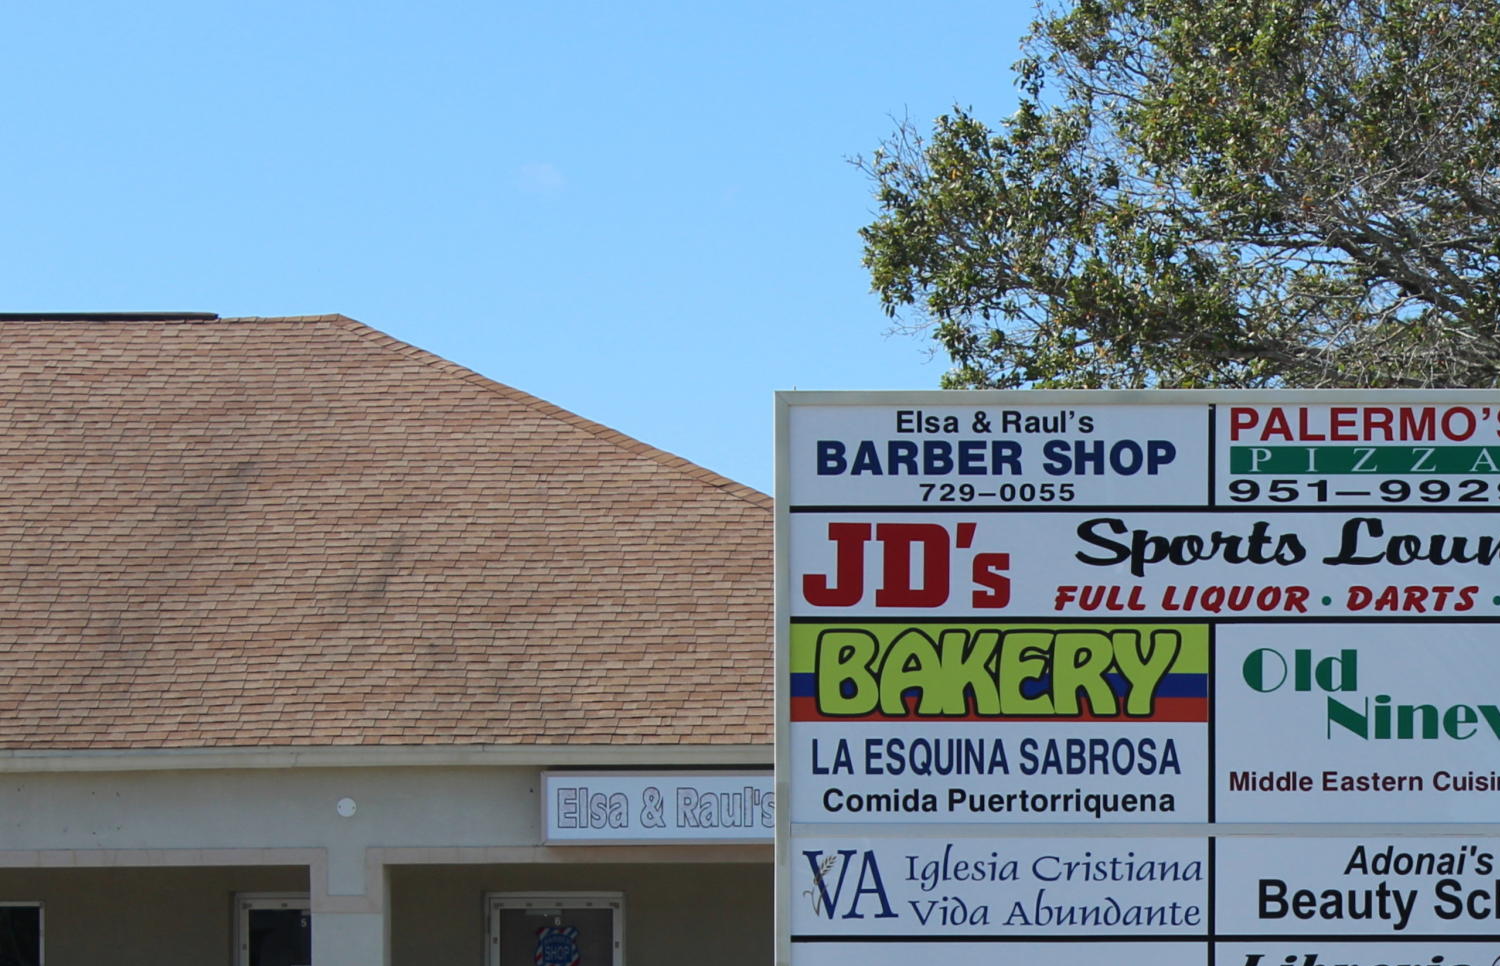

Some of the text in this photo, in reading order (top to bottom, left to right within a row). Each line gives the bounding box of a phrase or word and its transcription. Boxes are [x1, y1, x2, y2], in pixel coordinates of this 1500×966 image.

[897, 410, 1094, 433] Elsa & Raul's
[817, 440, 1176, 476] BARBER SHOP
[1249, 447, 1500, 472] PIZZA
[920, 483, 1074, 502] 729-0055
[803, 522, 1010, 608] JD's
[1075, 518, 1306, 577] Sports
[1054, 586, 1146, 611] FULL
[1161, 586, 1309, 613] LIQUOR
[1347, 586, 1479, 613] DARTS
[815, 628, 1182, 717] BAKERY
[1243, 648, 1357, 693] Old
[812, 738, 1181, 776] LA ESQUINA SABROSA
[1230, 771, 1313, 791] Middle
[1323, 771, 1423, 791] Eastern
[556, 786, 775, 829] Elsa & Raul's
[823, 788, 1174, 818] Comida Puertorriquena
[906, 844, 1202, 891] Iglesia Cristiana
[1344, 845, 1493, 875] Adonai's
[802, 850, 898, 919] VA
[908, 889, 1200, 926] Vida Abundante
[1259, 879, 1418, 930] Beauty
